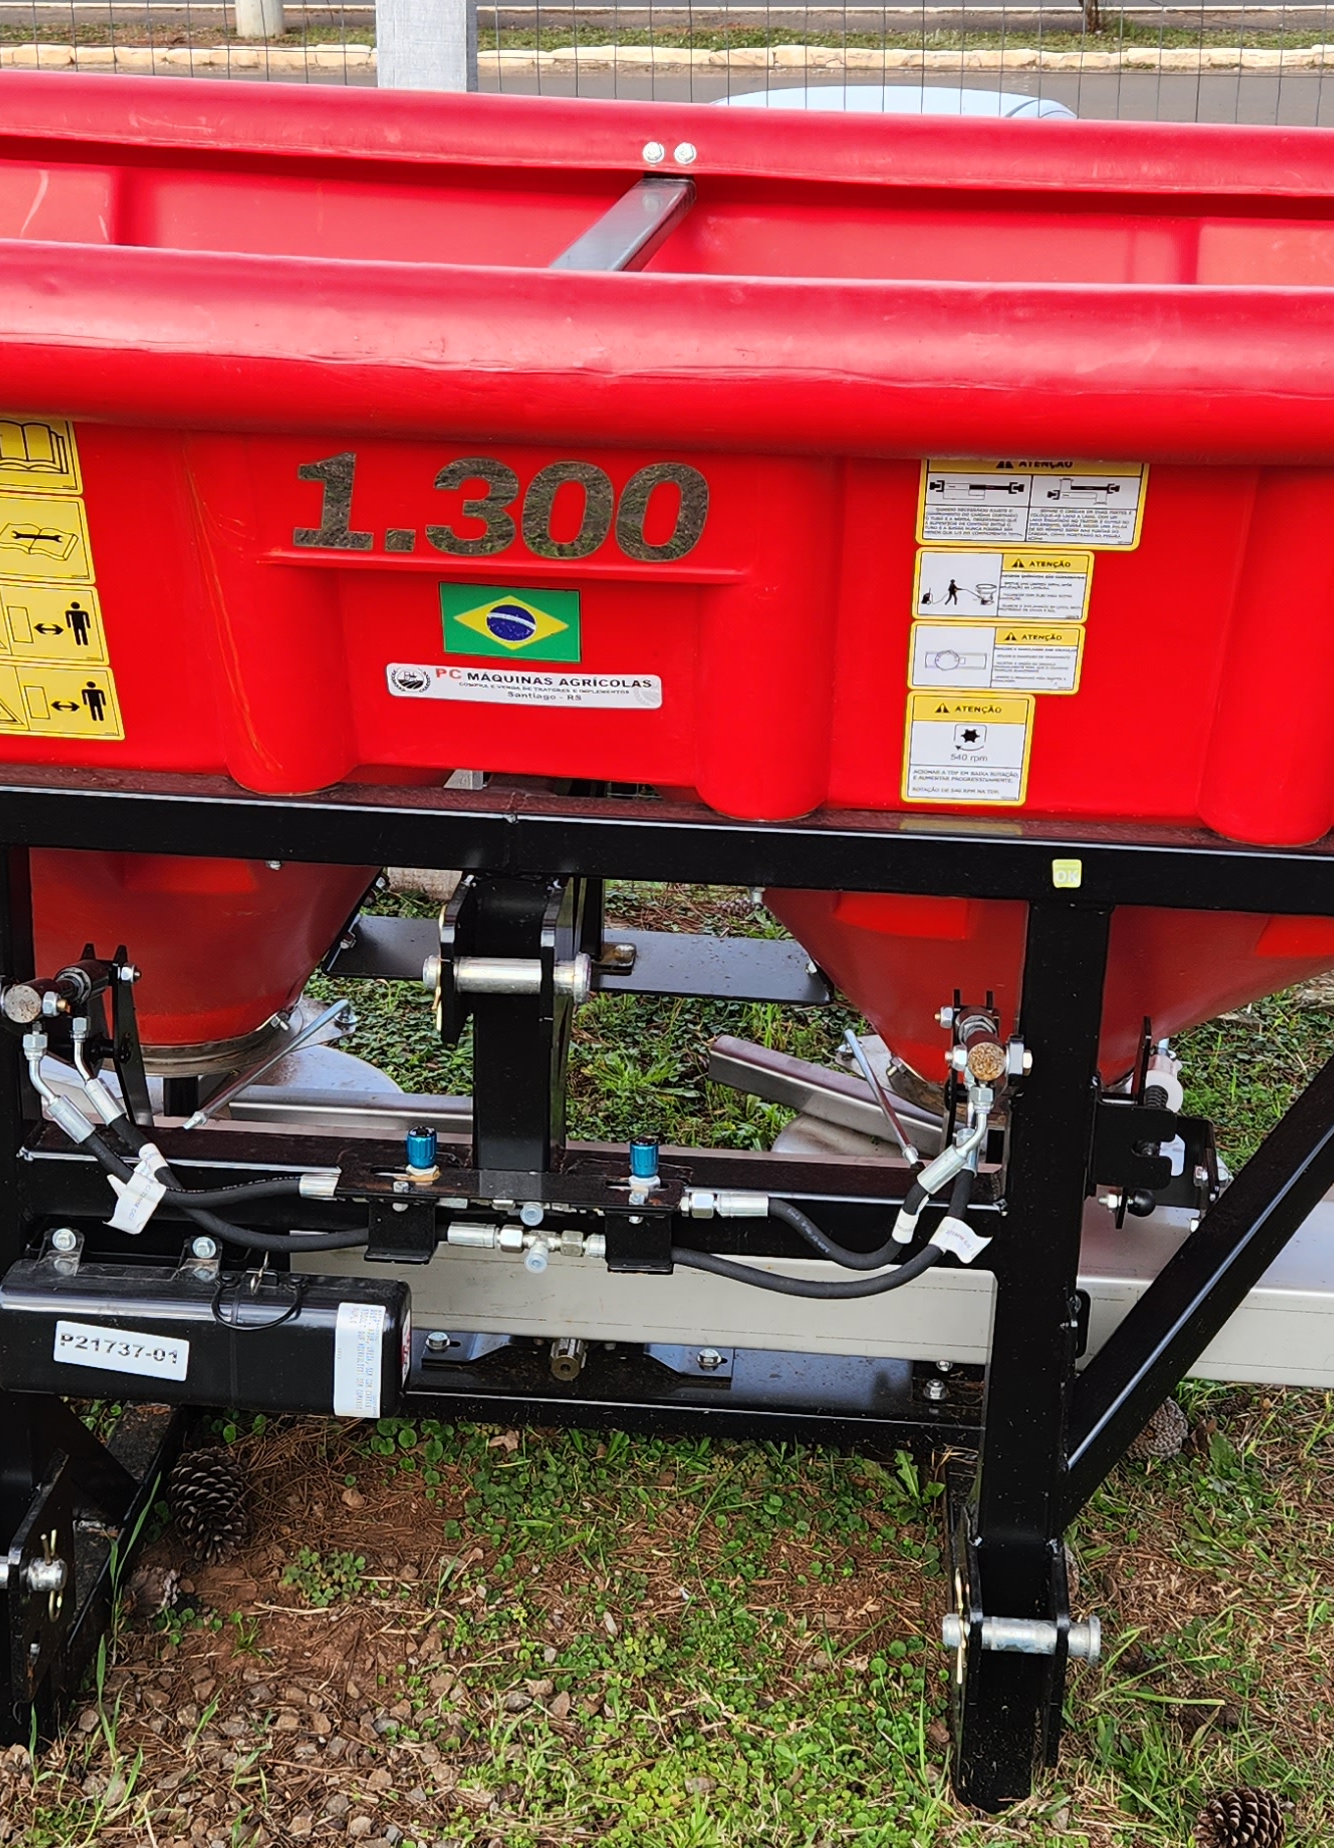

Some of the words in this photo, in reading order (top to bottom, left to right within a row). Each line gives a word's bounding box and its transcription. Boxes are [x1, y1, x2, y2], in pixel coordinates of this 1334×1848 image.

[292, 451, 710, 562] 1.300
[1028, 559, 1071, 569] ATENÇÃO
[1020, 632, 1063, 642] ATENÇÃO
[435, 667, 462, 680] PC
[467, 671, 553, 686] MÁQUINAS
[559, 676, 652, 688] AGRÍCOLAS
[507, 691, 556, 701] Santiago
[954, 704, 1002, 714] ATENÇÃO
[950, 753, 968, 762] 540
[970, 755, 988, 763] rpm
[1054, 869, 1079, 883] OK
[60, 1333, 179, 1364] P21737-01
